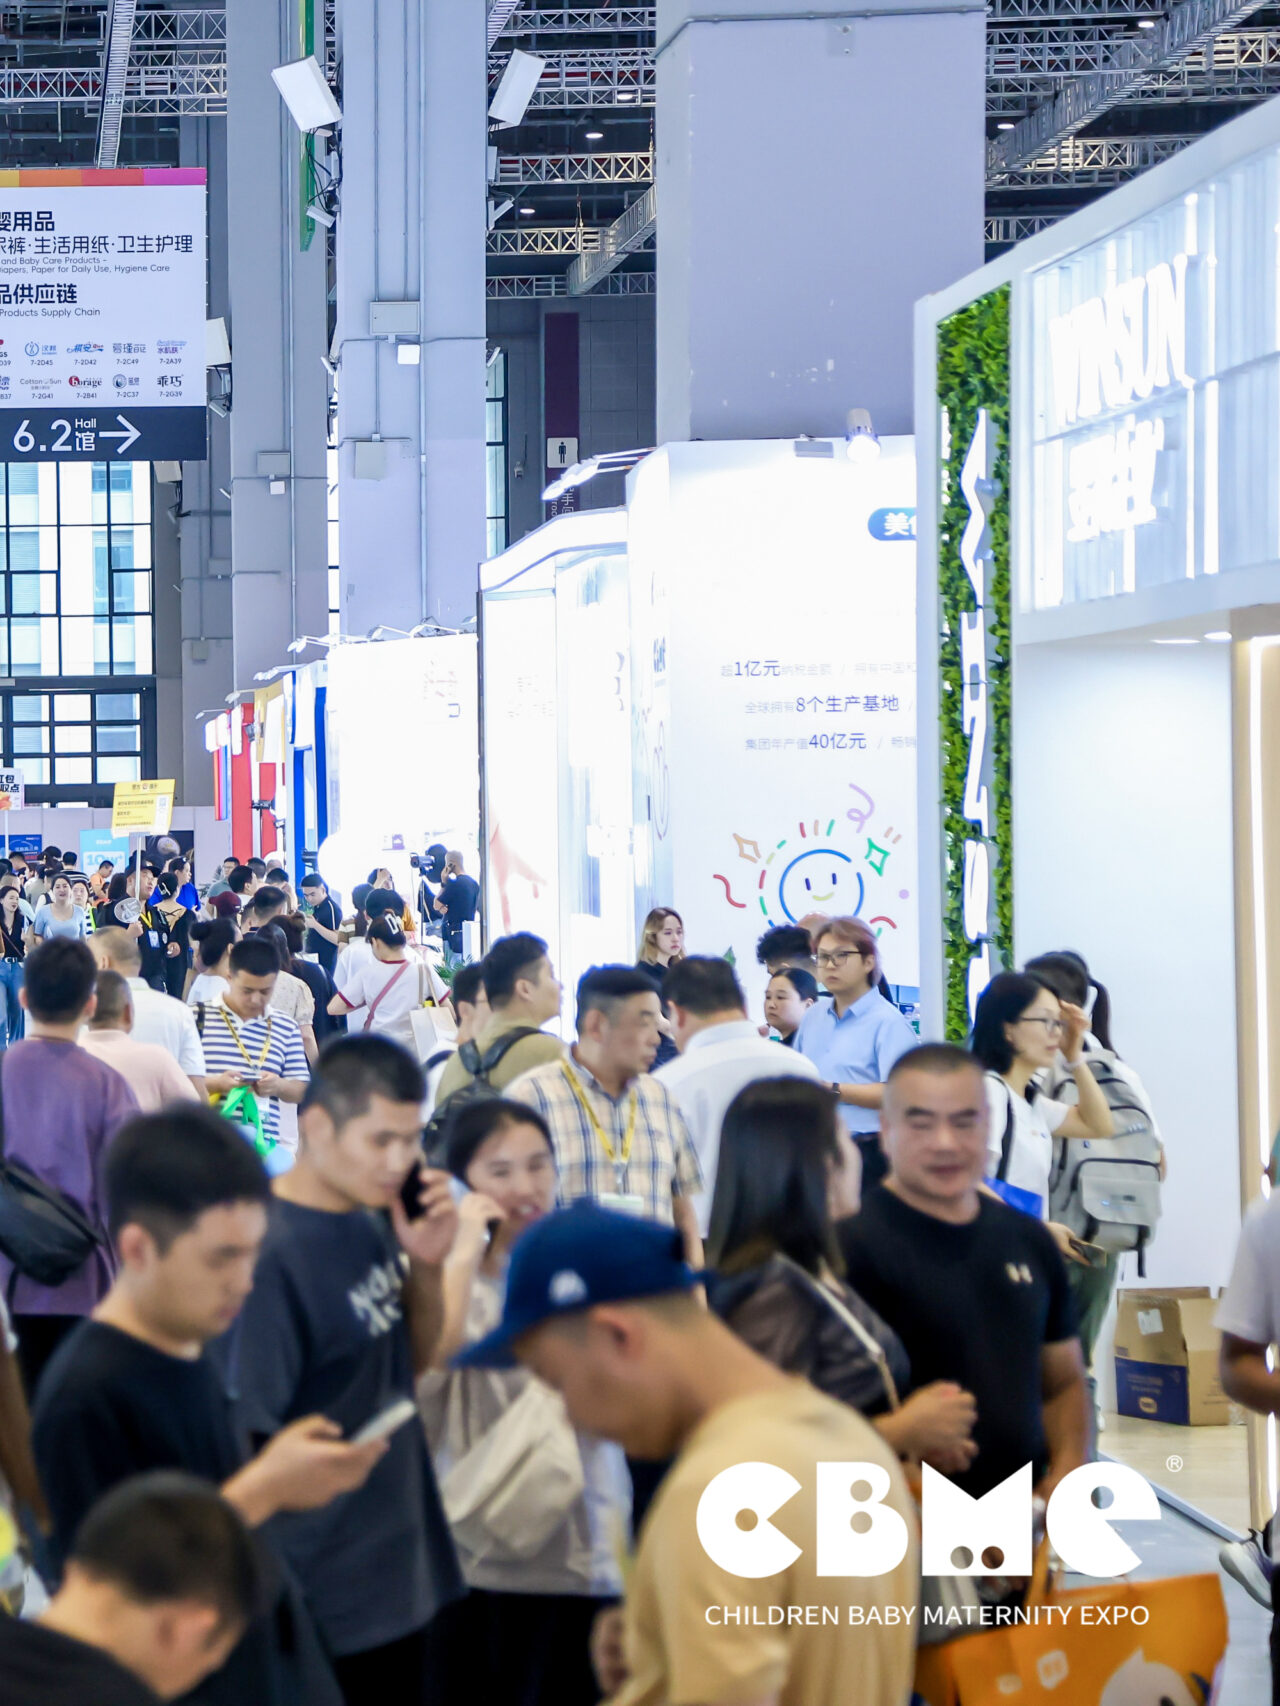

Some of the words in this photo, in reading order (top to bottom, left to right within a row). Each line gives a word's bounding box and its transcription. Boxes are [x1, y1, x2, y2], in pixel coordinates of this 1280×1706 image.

[1, 257, 17, 265] and
[19, 257, 40, 267] Baby
[42, 257, 63, 265] Care
[65, 256, 101, 264] Products
[31, 266, 56, 274] Paper
[57, 265, 69, 273] for
[71, 265, 91, 274] Daily
[114, 265, 148, 274] Hygiene
[150, 264, 170, 272] Care
[41, 308, 71, 318] Supply
[74, 308, 101, 316] Chain
[75, 418, 97, 430] Hall
[13, 419, 72, 452] 6.2
[75, 431, 96, 452] 馆
[561, 487, 574, 514] 手间
